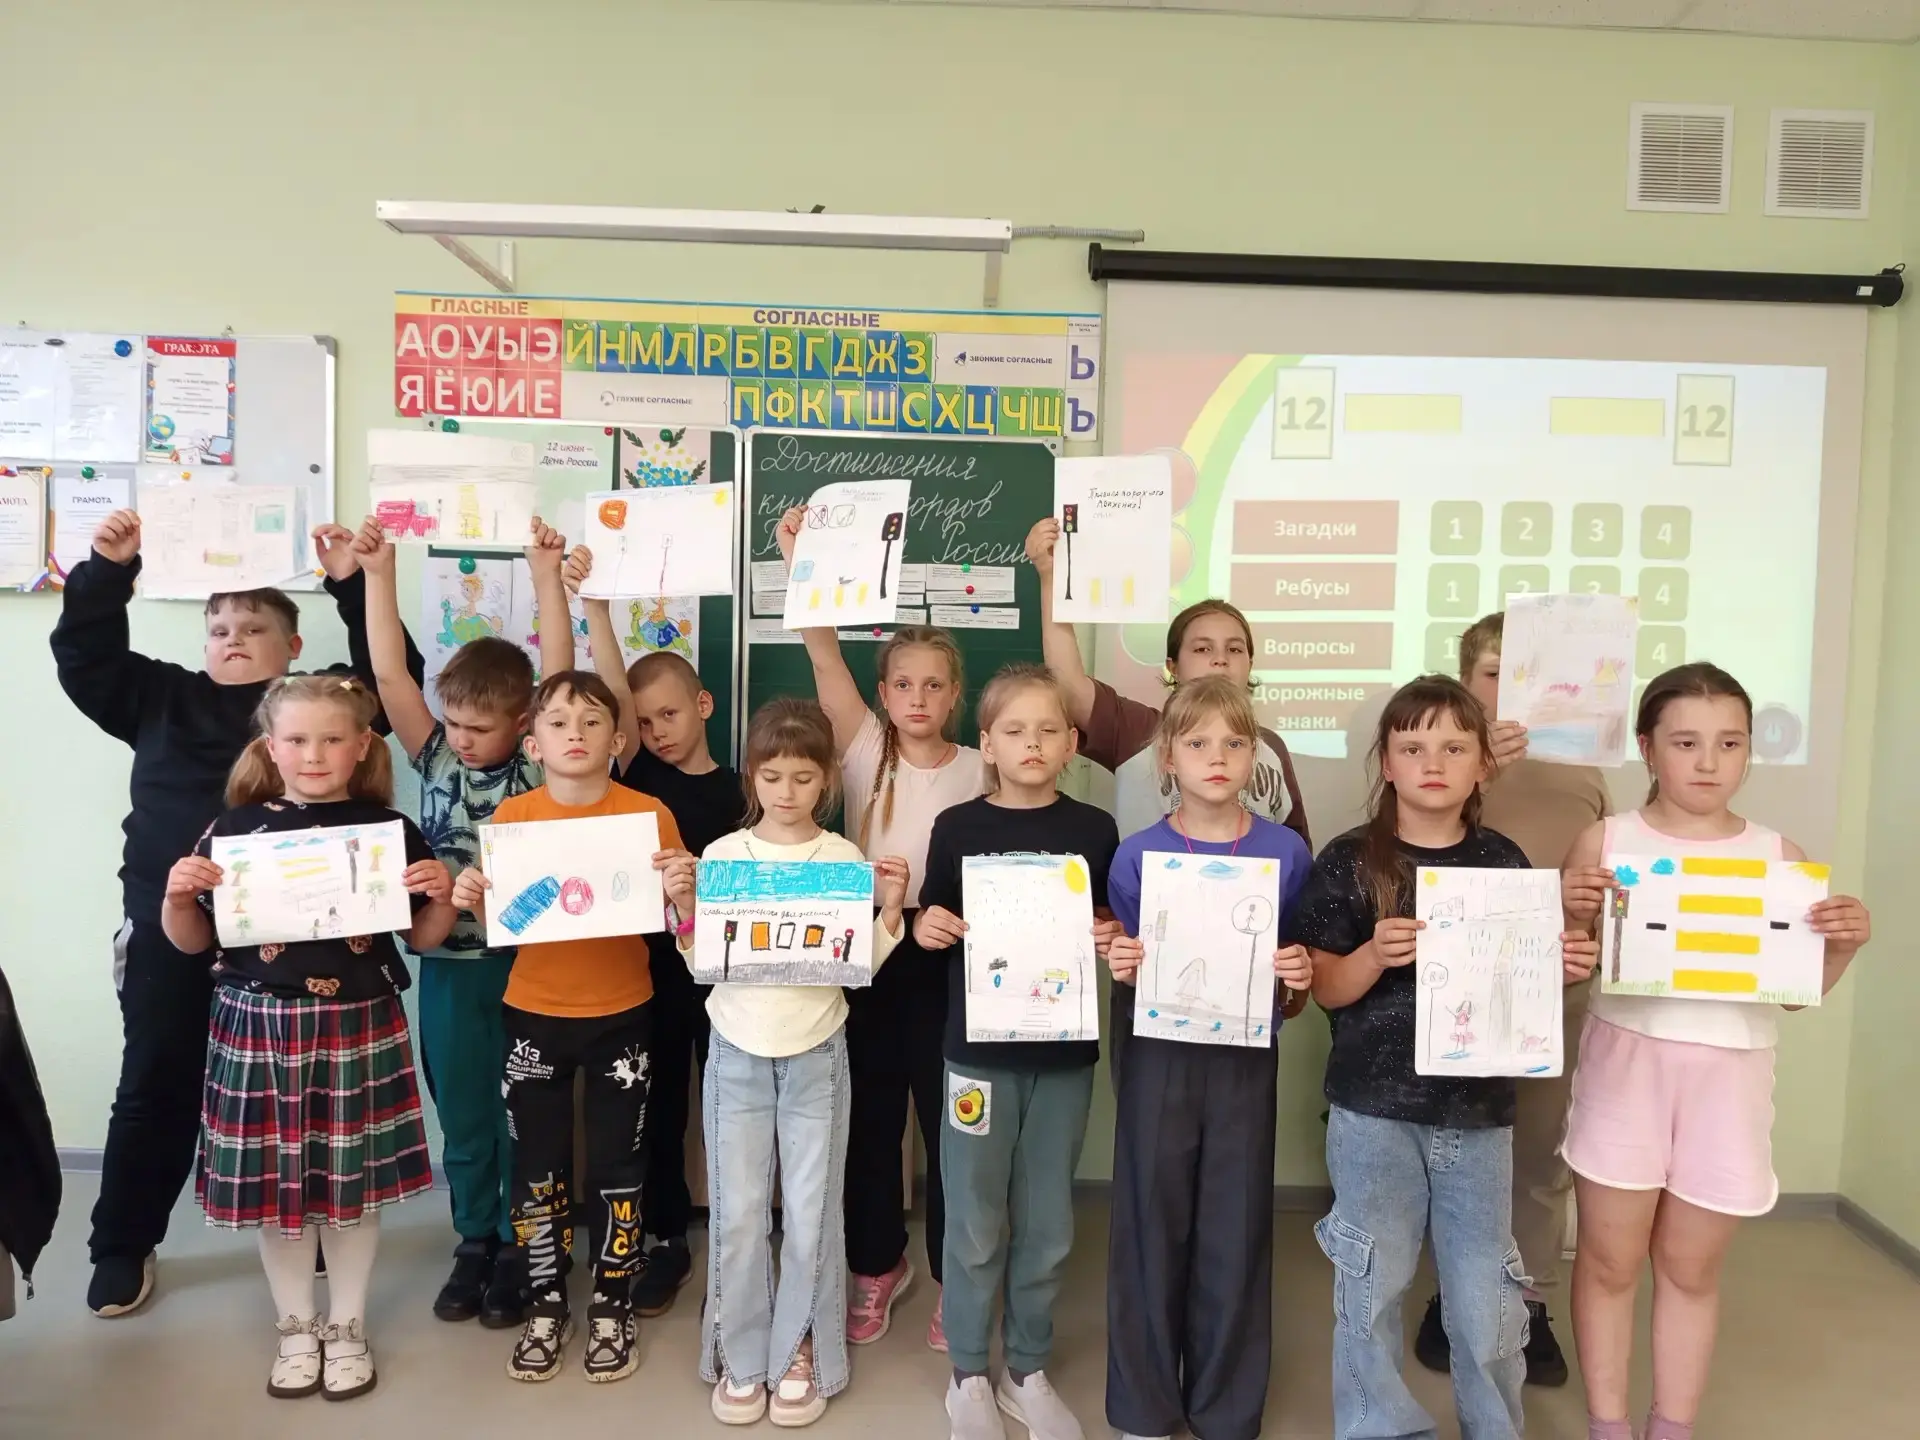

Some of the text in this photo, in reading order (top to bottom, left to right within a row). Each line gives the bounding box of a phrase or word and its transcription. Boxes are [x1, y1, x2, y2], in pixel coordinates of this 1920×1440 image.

[430, 298, 529, 316] ГЛАСНЫЕ
[753, 309, 880, 328] СОГЛАСНЫЕ
[969, 355, 1053, 365] ЗВОНКИЕ СОГЛАСНЫЕ
[616, 395, 693, 405] ГЛУХИЕ СОГЛАСНЫЕ
[1280, 396, 1326, 431] 12
[1681, 404, 1727, 438] 12
[547, 441, 558, 451] 12
[560, 444, 585, 452] июня
[540, 455, 598, 467] День России
[760, 435, 978, 480] Достижения
[0, 496, 28, 506] МОТА
[72, 496, 113, 504] ГРАМОТА
[907, 480, 1003, 540] ордов
[1274, 519, 1673, 545] Загадки 1 2 3 4
[1275, 578, 1350, 601] Ребусы
[1446, 580, 1460, 602] 1
[1655, 584, 1671, 605] 4
[1264, 636, 1668, 664] Вопросы 1 4
[1252, 685, 1366, 705] Дорожные
[1277, 715, 1337, 730] знаки
[513, 1038, 541, 1062] X13
[506, 1061, 554, 1076] EQUIPMENT
[508, 1053, 555, 1072] POLO TEAM
